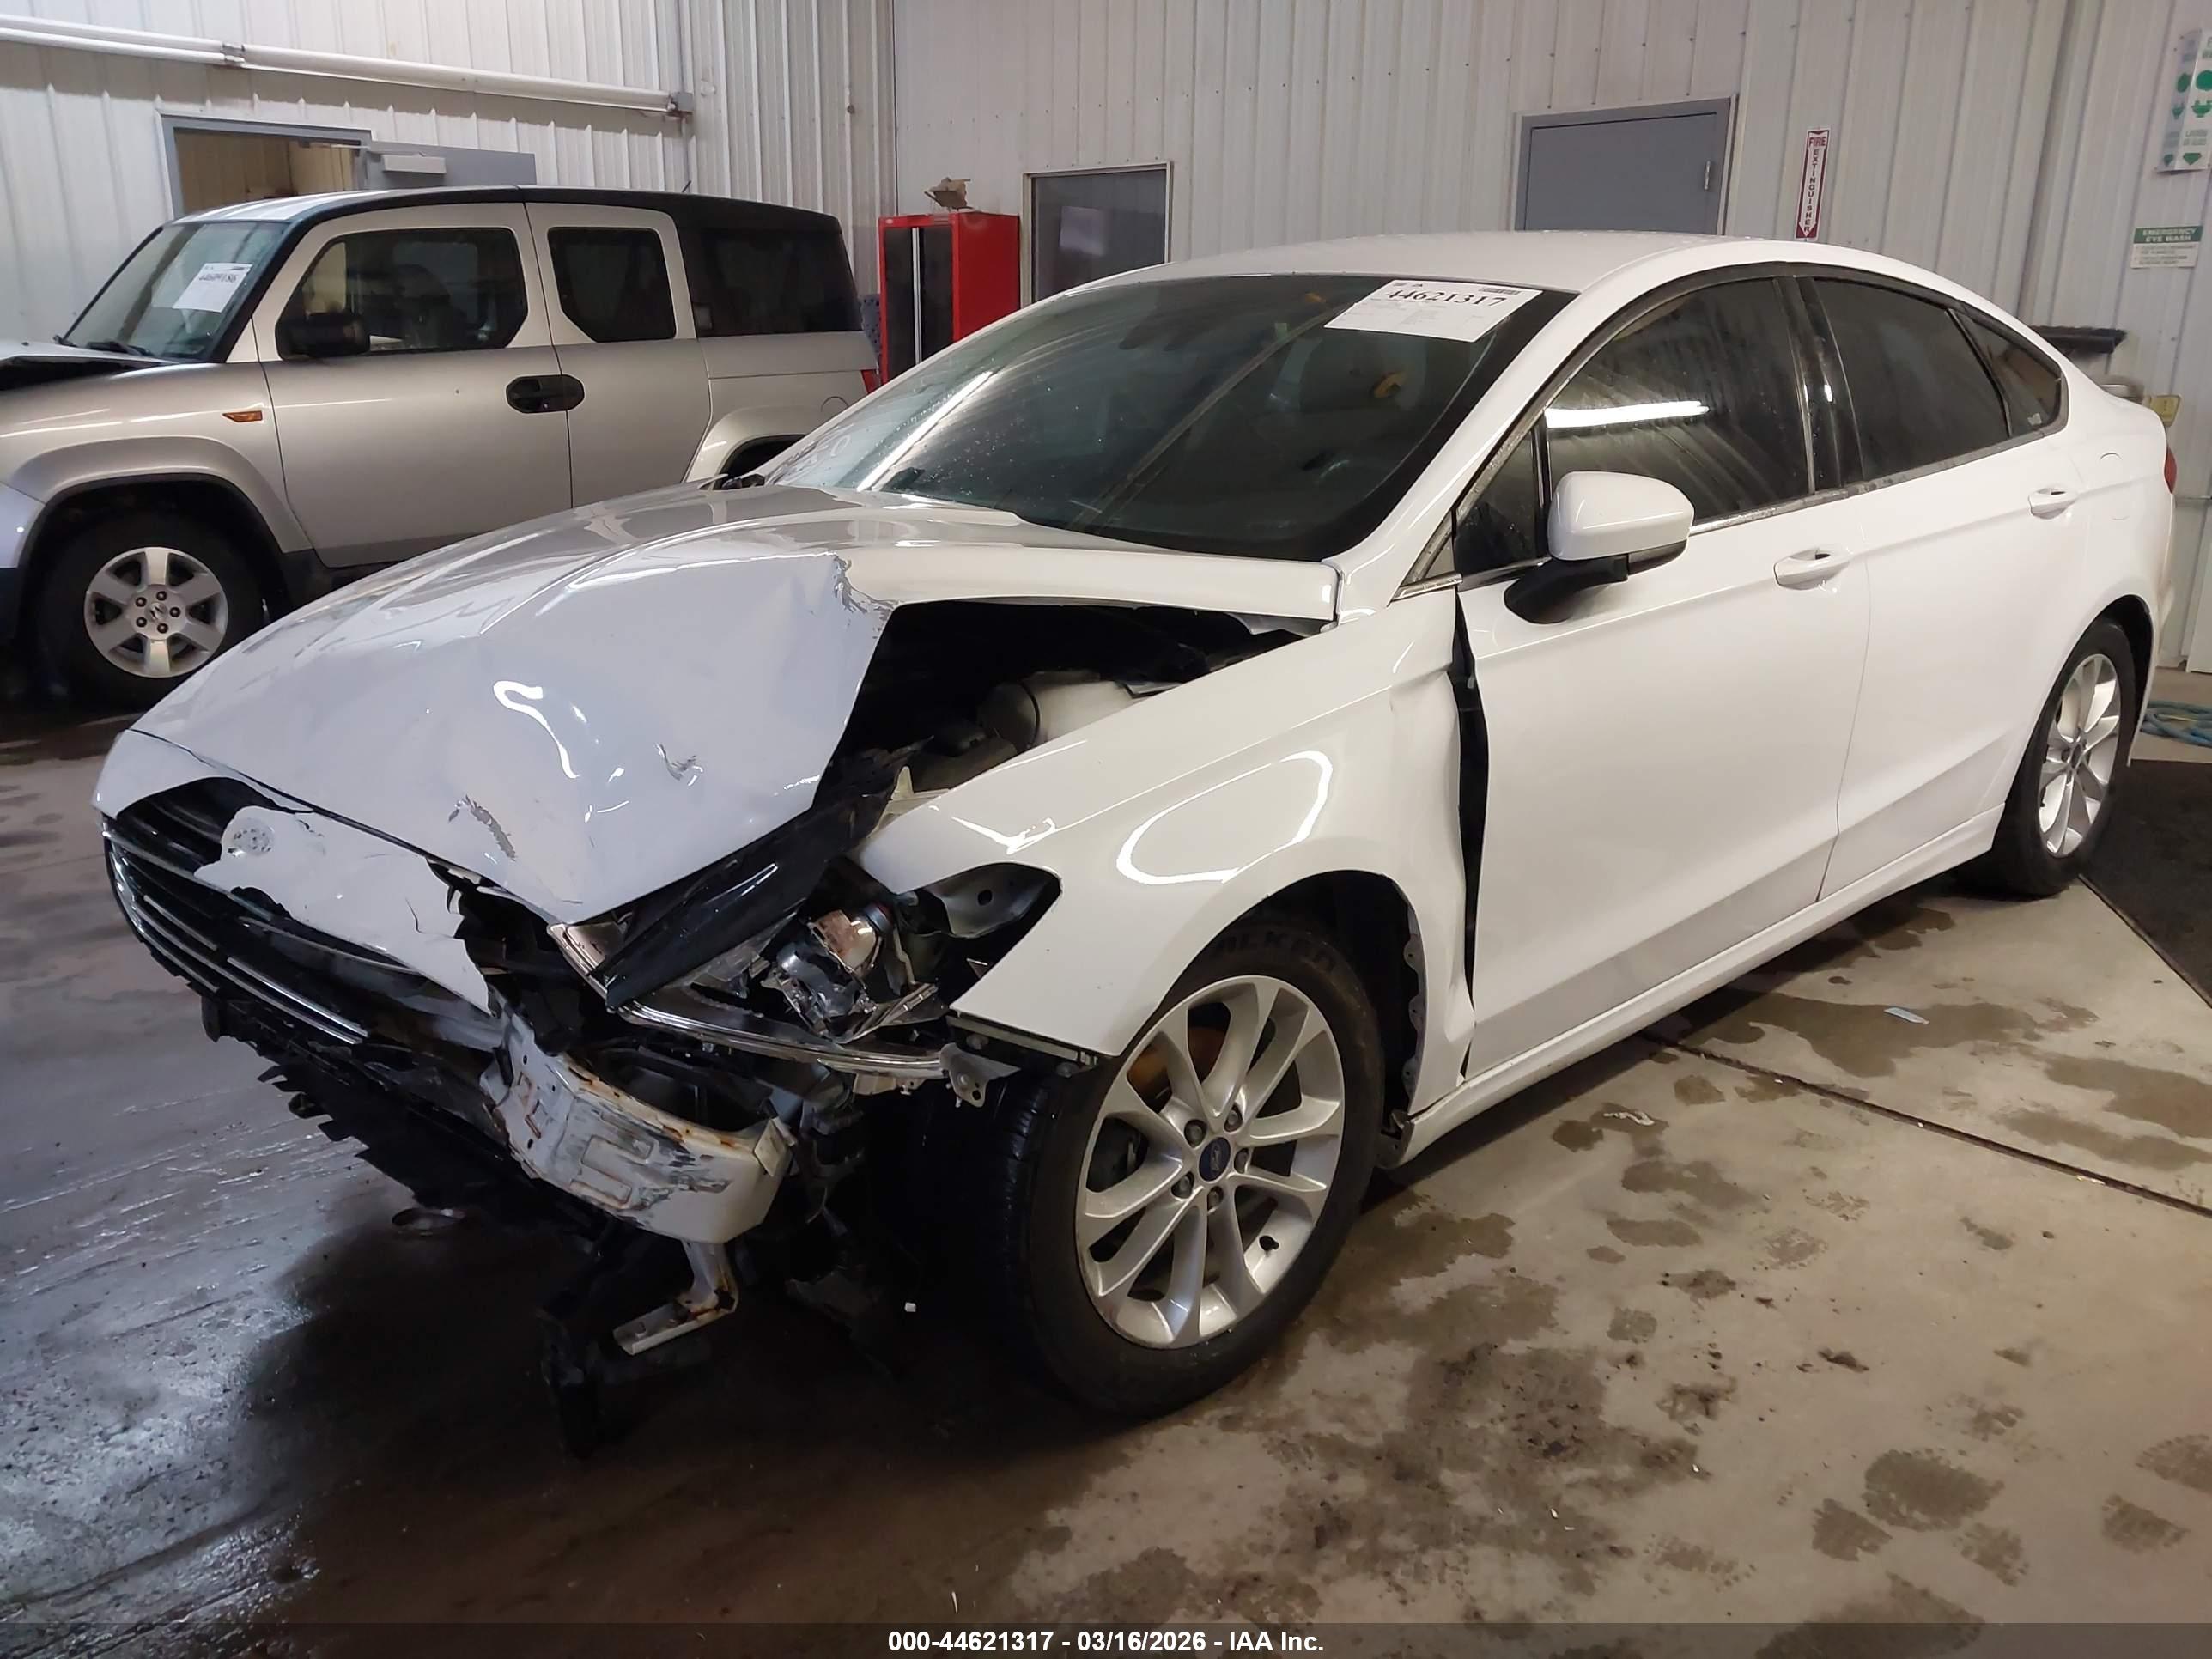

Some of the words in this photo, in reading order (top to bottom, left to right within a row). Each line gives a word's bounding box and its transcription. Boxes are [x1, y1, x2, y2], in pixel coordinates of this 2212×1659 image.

[1808, 137, 1826, 148] FIRE
[1804, 149, 1820, 232] EXTINGUISHER
[2166, 234, 2192, 242] WASH
[1385, 289, 1506, 307] 44621317
